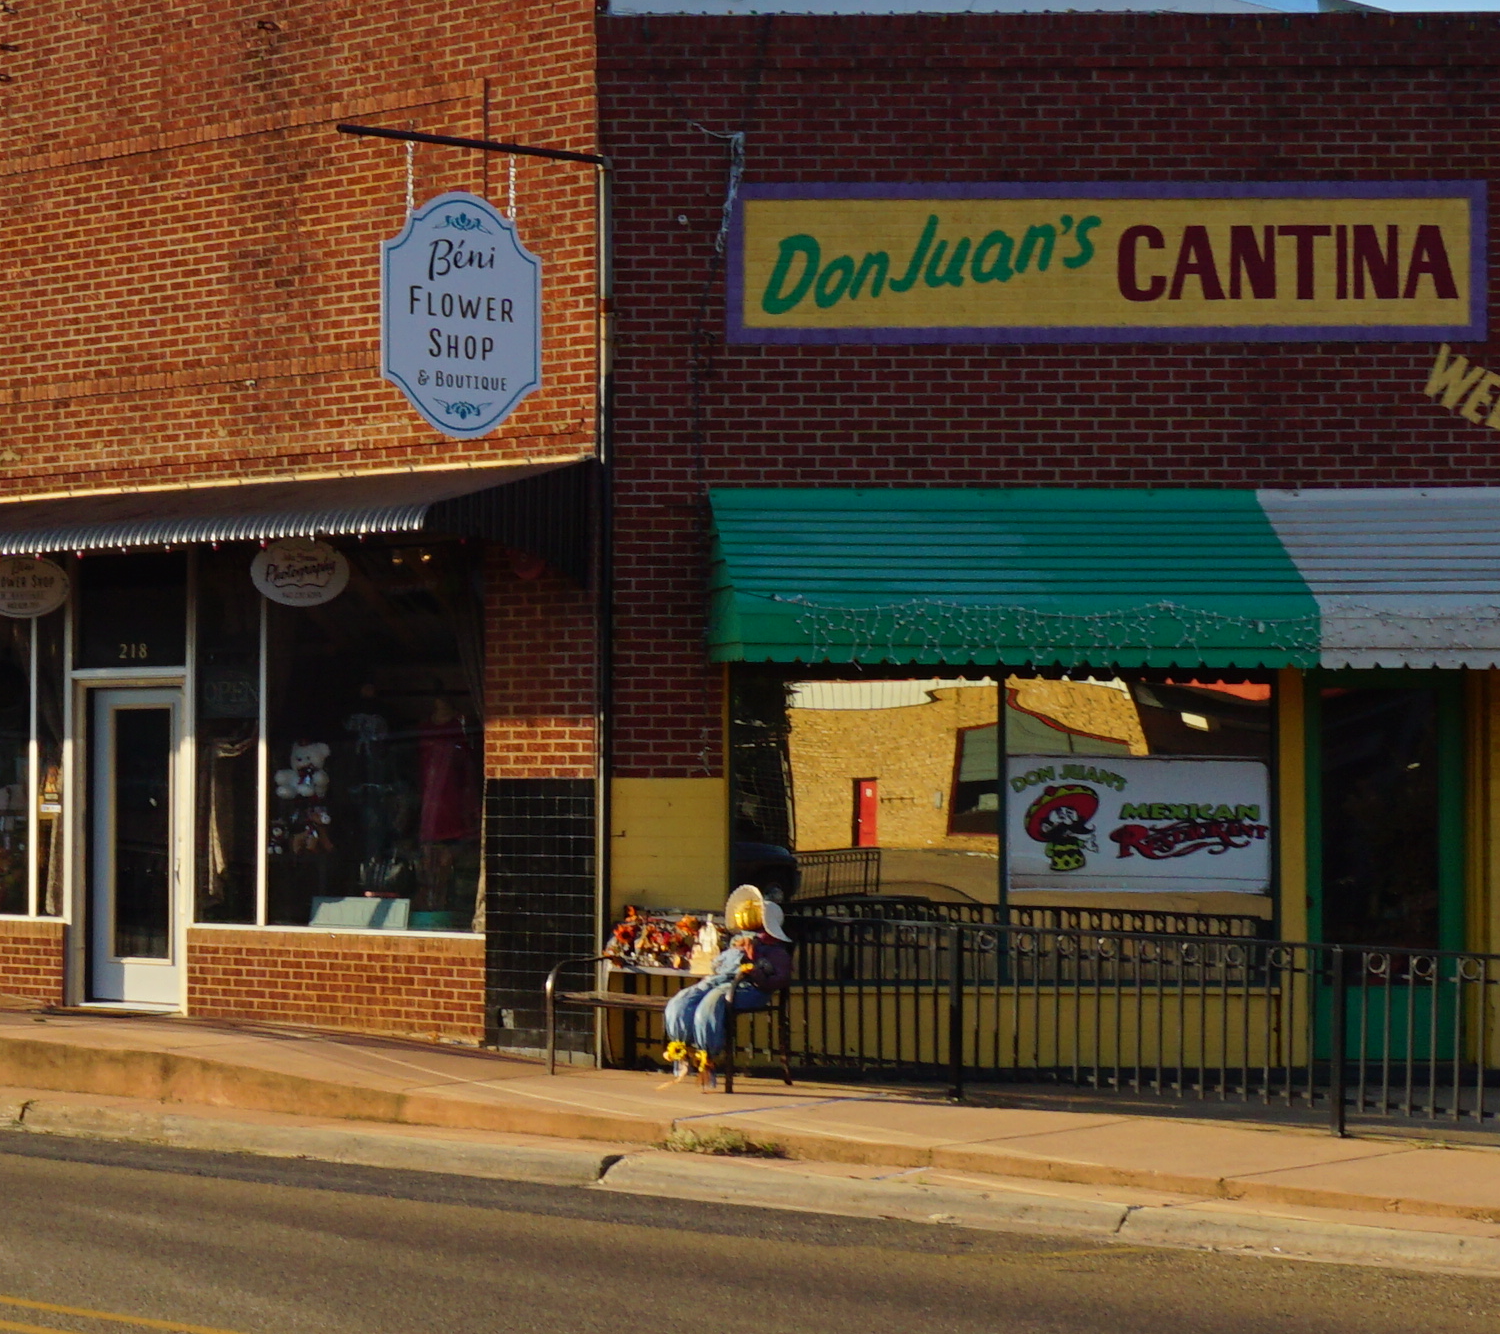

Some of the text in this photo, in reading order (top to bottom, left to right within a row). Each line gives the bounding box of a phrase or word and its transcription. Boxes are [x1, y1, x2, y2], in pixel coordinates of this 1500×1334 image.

[428, 238, 496, 281] Béni
[1116, 223, 1460, 303] CANTINA
[409, 285, 514, 323] FLOWER
[428, 328, 494, 361] SHOP
[417, 369, 507, 392] & BOUTIQUE
[118, 643, 149, 659] 218
[1010, 765, 1055, 793] DON
[1119, 803, 1261, 820] MEXICAN
